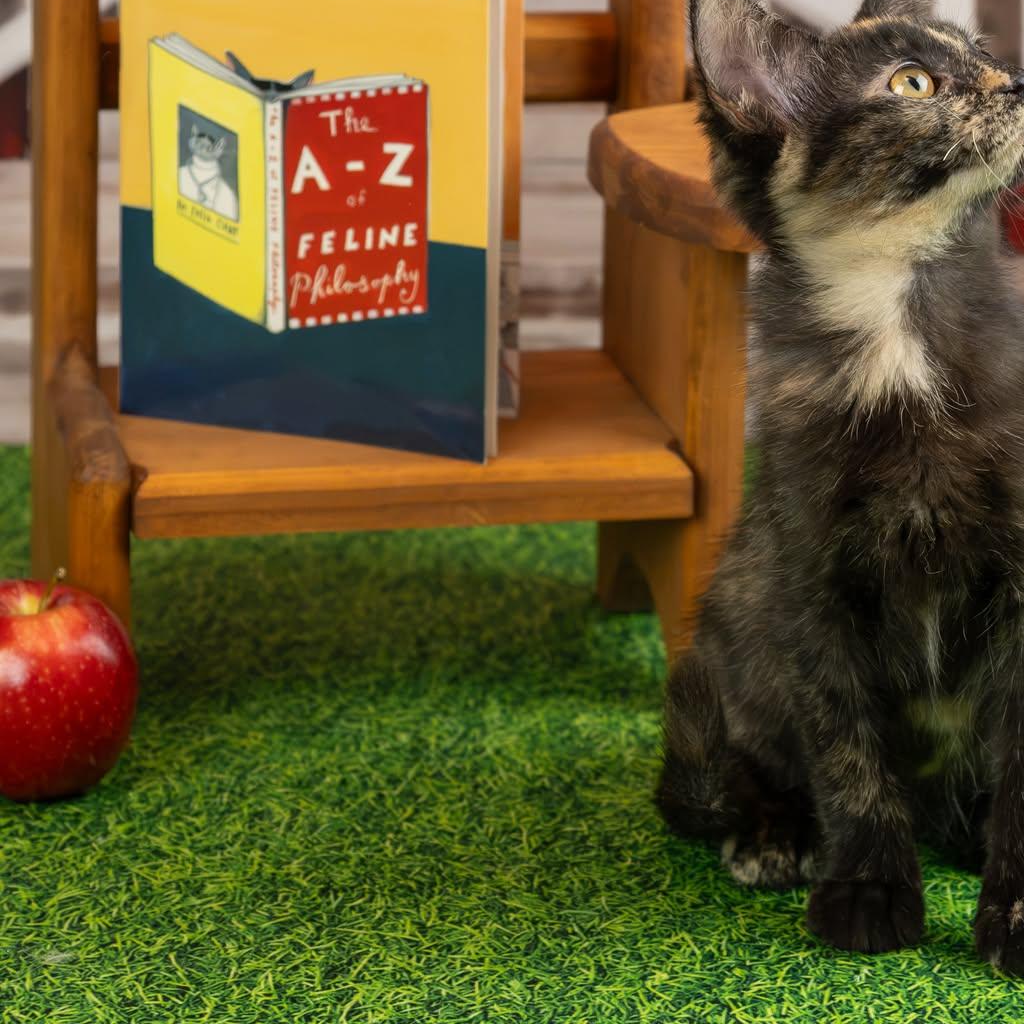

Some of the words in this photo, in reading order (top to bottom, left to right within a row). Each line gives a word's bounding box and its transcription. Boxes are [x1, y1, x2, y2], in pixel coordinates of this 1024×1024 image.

[319, 107, 378, 137] The
[346, 190, 367, 207] of
[297, 223, 418, 259] FELINE
[289, 259, 420, 309] Philosophy
